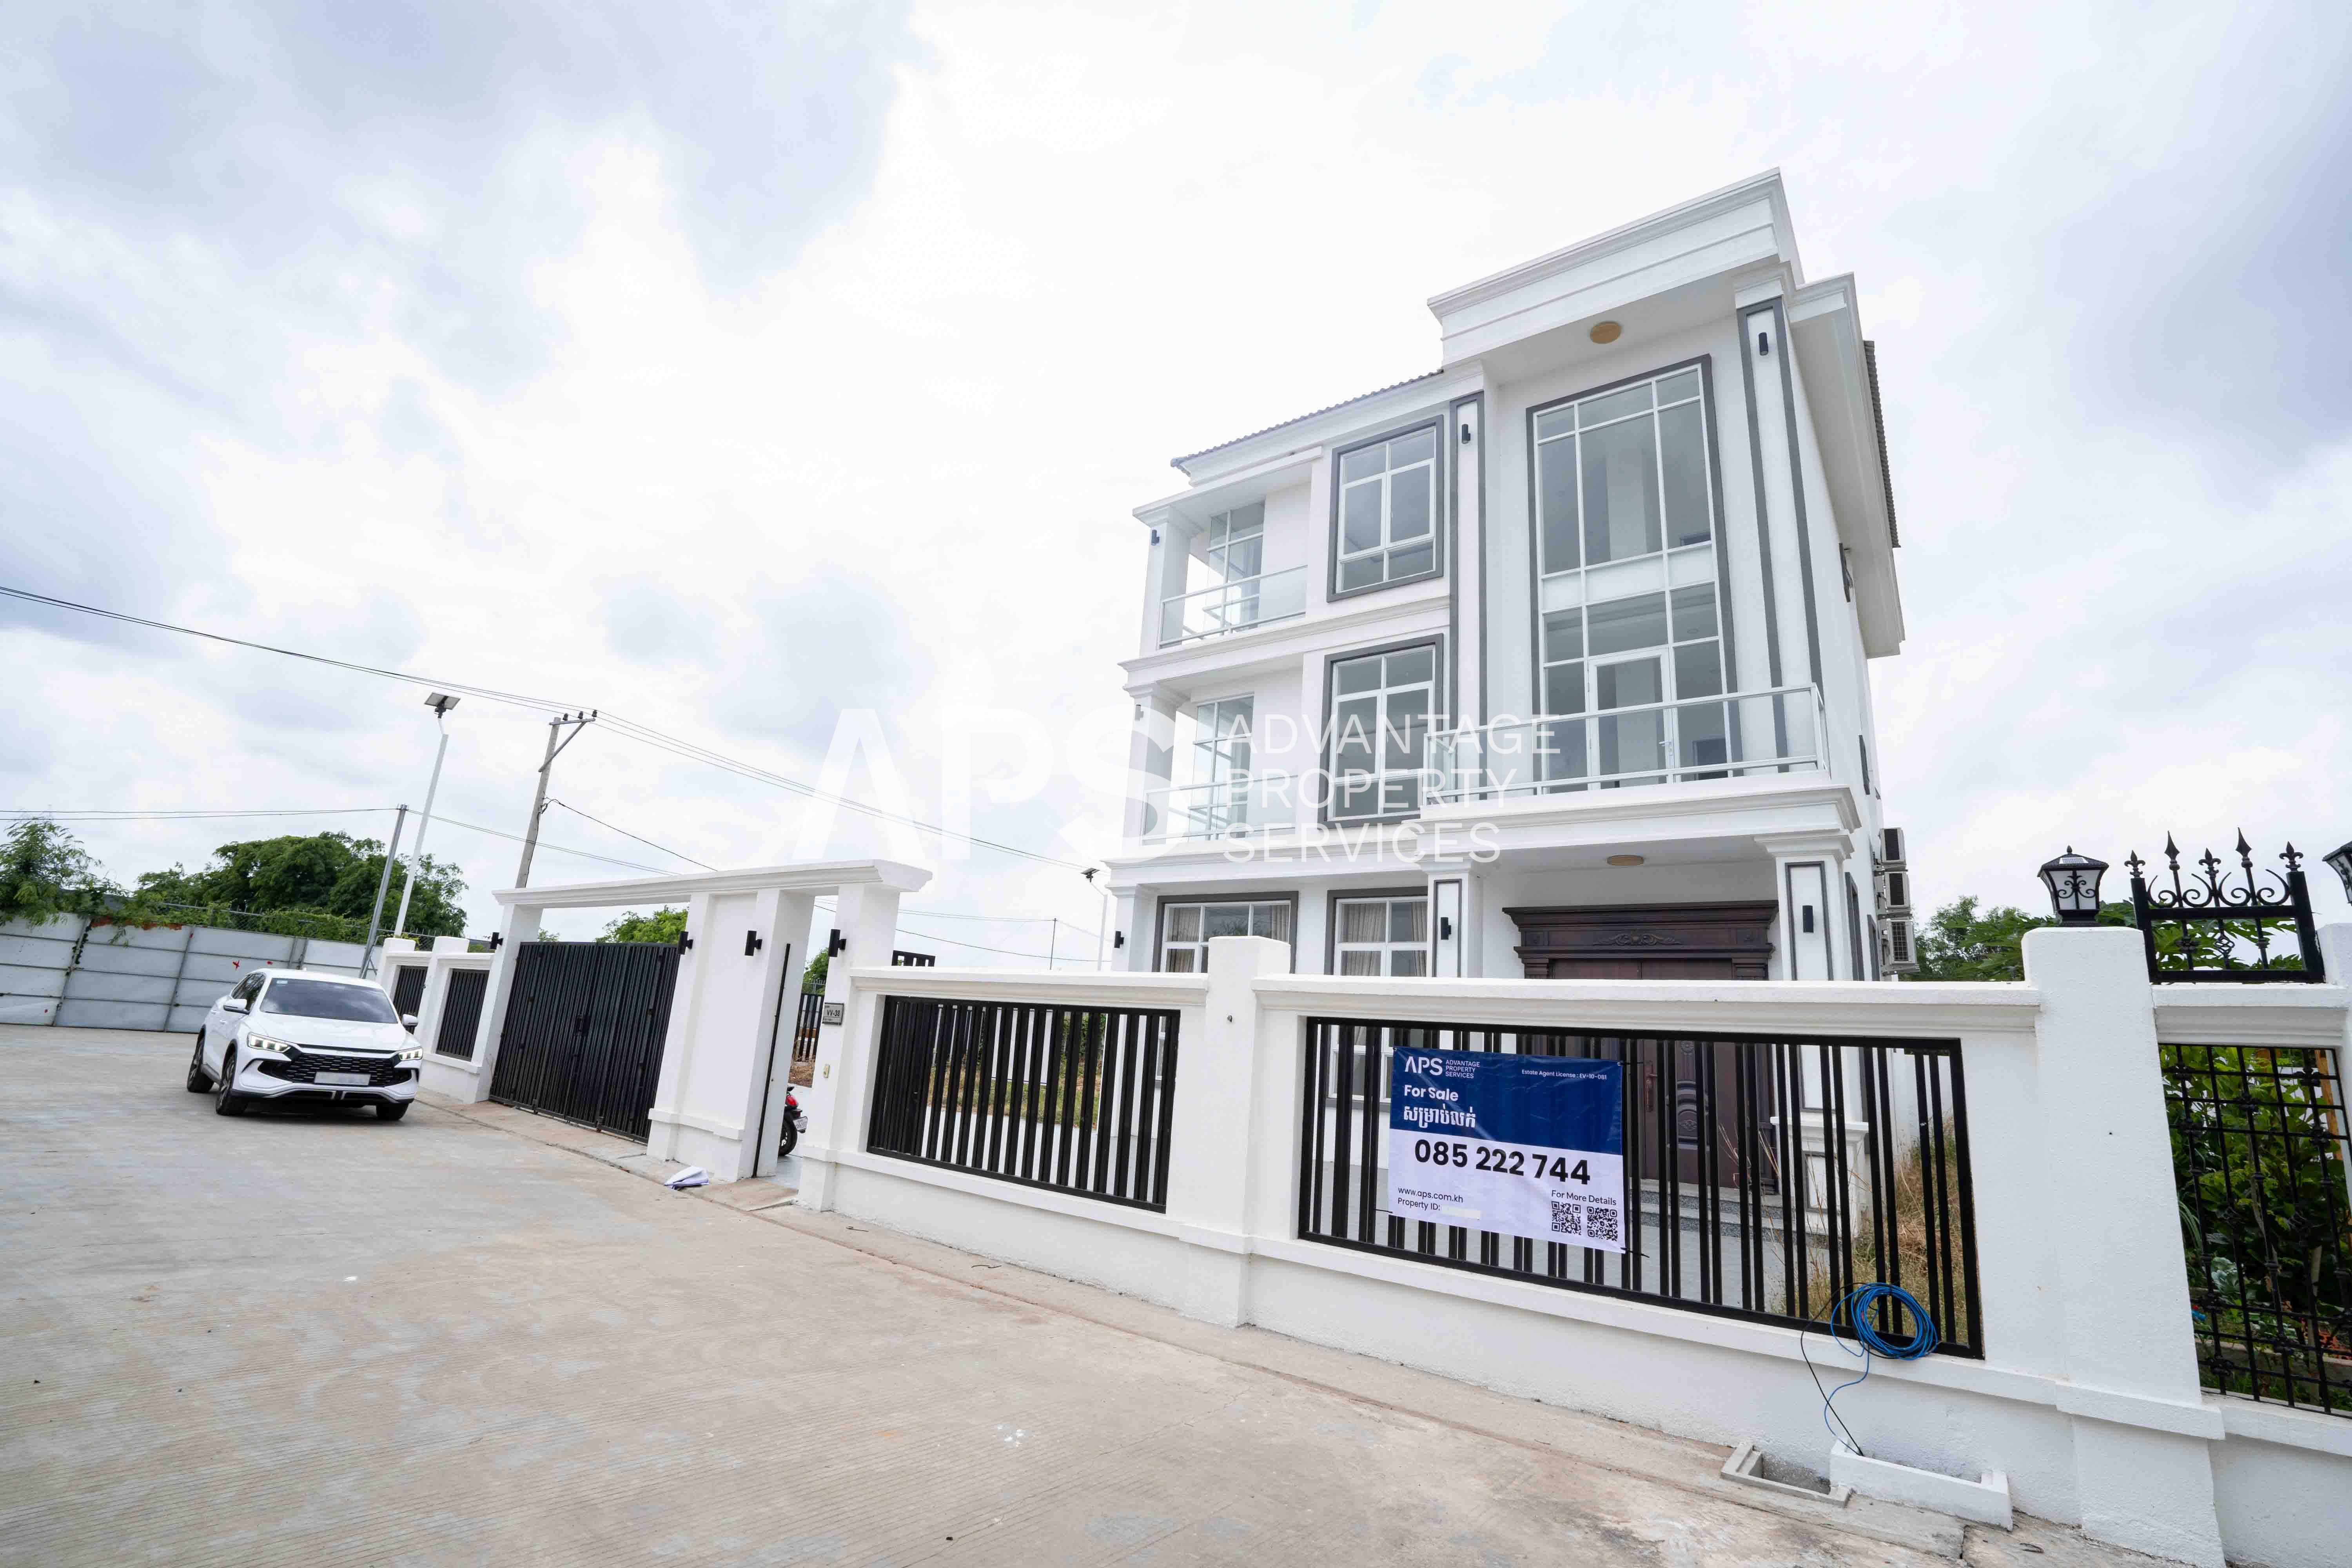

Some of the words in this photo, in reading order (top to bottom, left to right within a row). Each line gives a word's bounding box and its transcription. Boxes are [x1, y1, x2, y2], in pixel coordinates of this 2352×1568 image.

[1405, 1056, 1443, 1076] APS
[1404, 1085, 1426, 1098] For
[1428, 1087, 1459, 1102] Sale
[1415, 1139, 1468, 1167] 085
[1475, 1146, 1524, 1176] 222
[1532, 1154, 1591, 1185] 744
[1398, 1187, 1463, 1203] www.aps.com.kh
[1552, 1190, 1565, 1198] For
[1566, 1191, 1587, 1201] More
[1588, 1195, 1617, 1205] Details
[1397, 1198, 1428, 1211] Property
